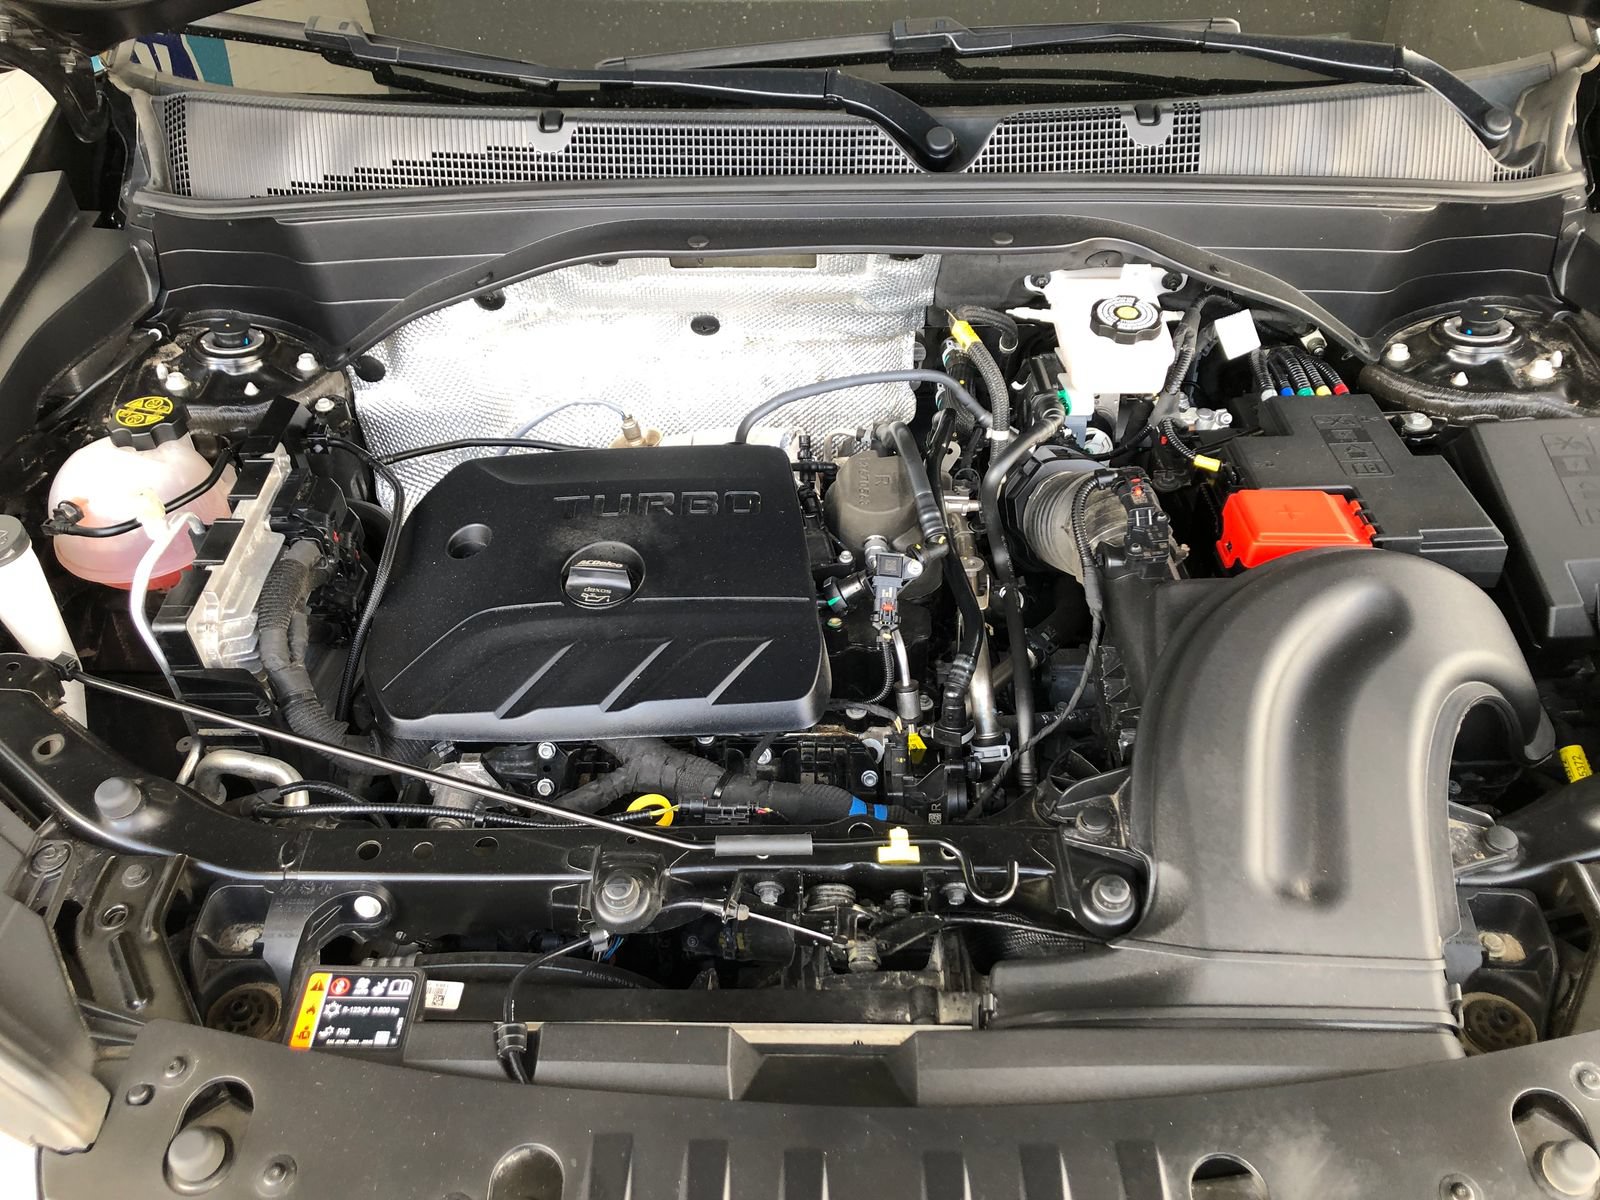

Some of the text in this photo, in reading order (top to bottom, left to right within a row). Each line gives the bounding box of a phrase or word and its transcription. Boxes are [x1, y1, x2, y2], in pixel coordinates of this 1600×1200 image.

[553, 490, 762, 518] TURBO
[576, 560, 623, 568] ACDelco
[583, 586, 612, 594] dexos
[1572, 755, 1586, 777] 5372
[931, 803, 941, 811] R
[337, 1027, 350, 1036] PAG
